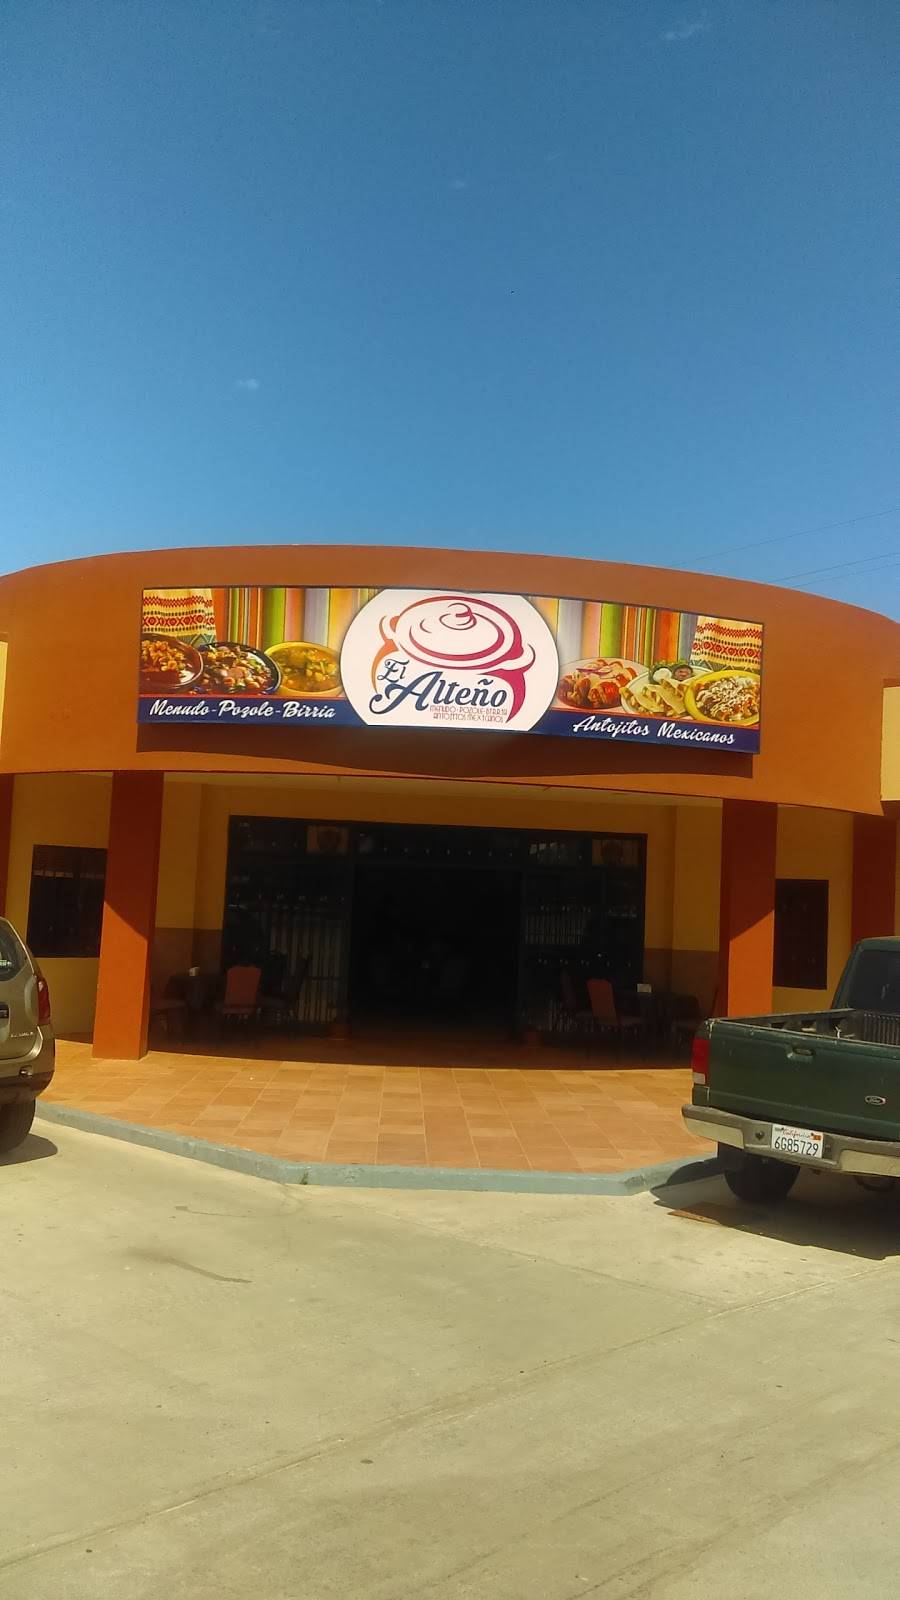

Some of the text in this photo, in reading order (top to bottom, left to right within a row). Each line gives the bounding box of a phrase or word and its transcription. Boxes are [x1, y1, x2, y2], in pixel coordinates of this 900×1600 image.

[377, 658, 410, 683] El
[369, 671, 507, 715] Alteño
[573, 715, 735, 744] Antojitos Mexicanos
[774, 1136, 819, 1157] 6G85729
